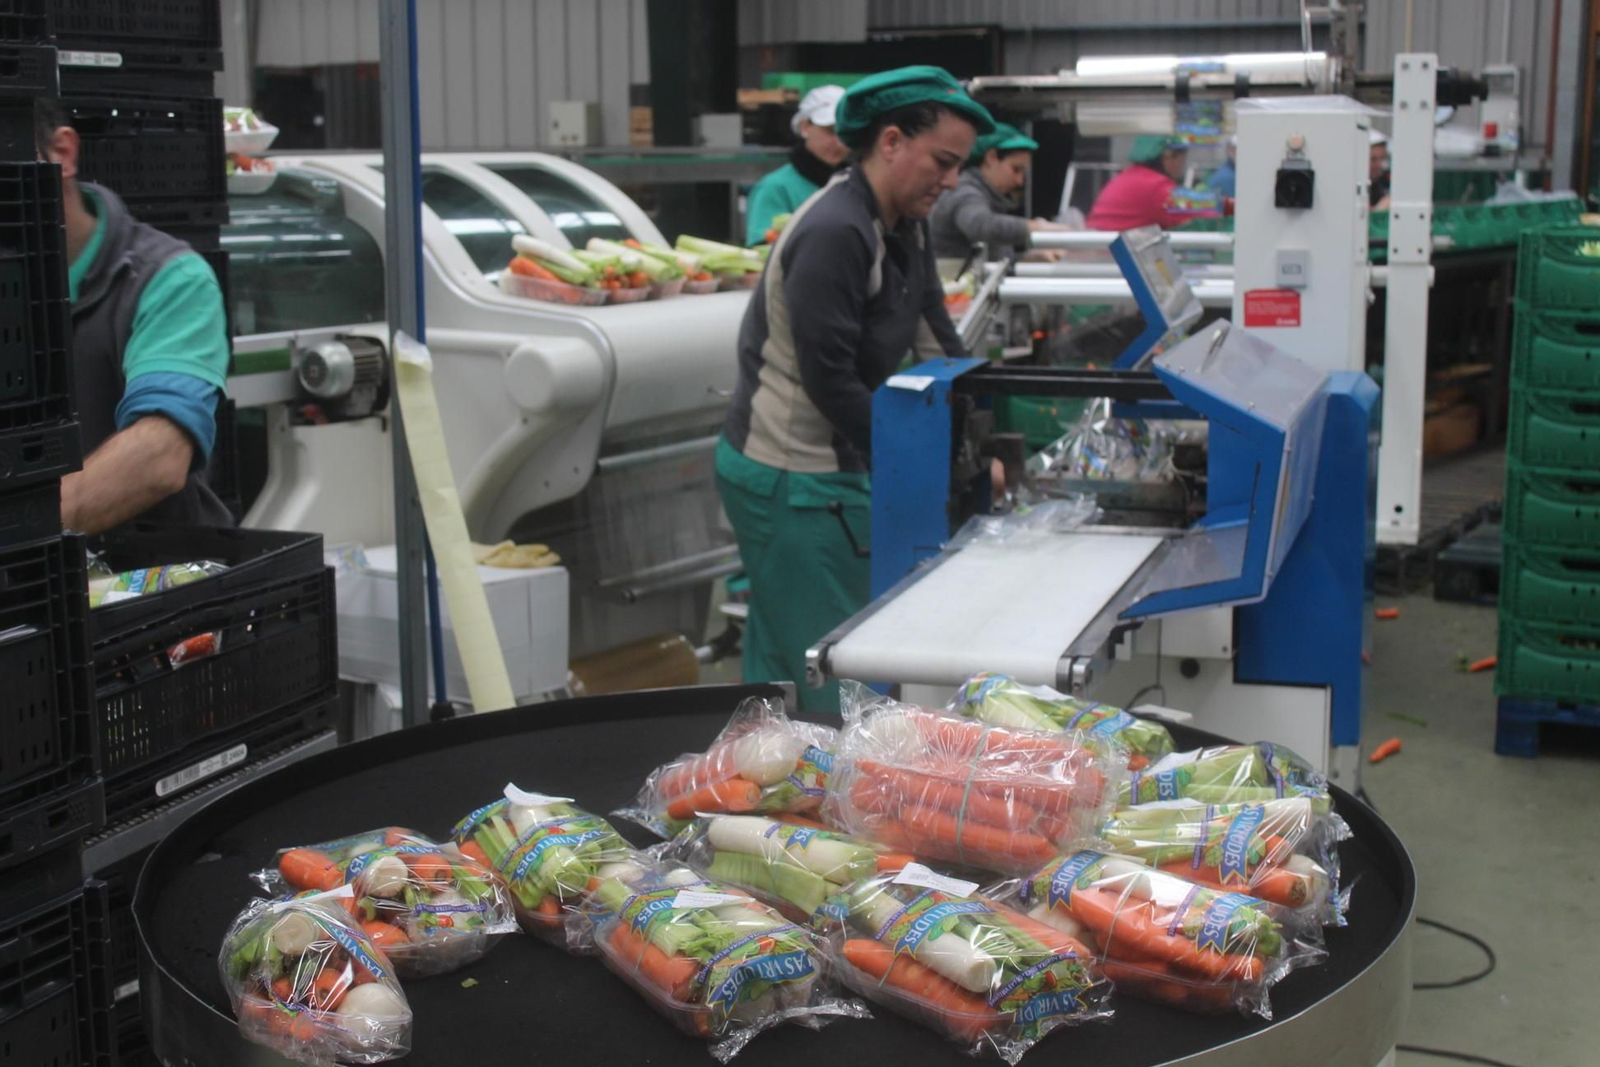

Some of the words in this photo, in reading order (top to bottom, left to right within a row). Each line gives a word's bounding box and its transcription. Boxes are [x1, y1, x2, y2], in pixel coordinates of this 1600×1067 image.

[516, 835, 576, 875] VIRTUDES
[638, 900, 673, 924] UDES
[905, 902, 966, 943] VIRTUDES
[361, 954, 383, 979] LAS
